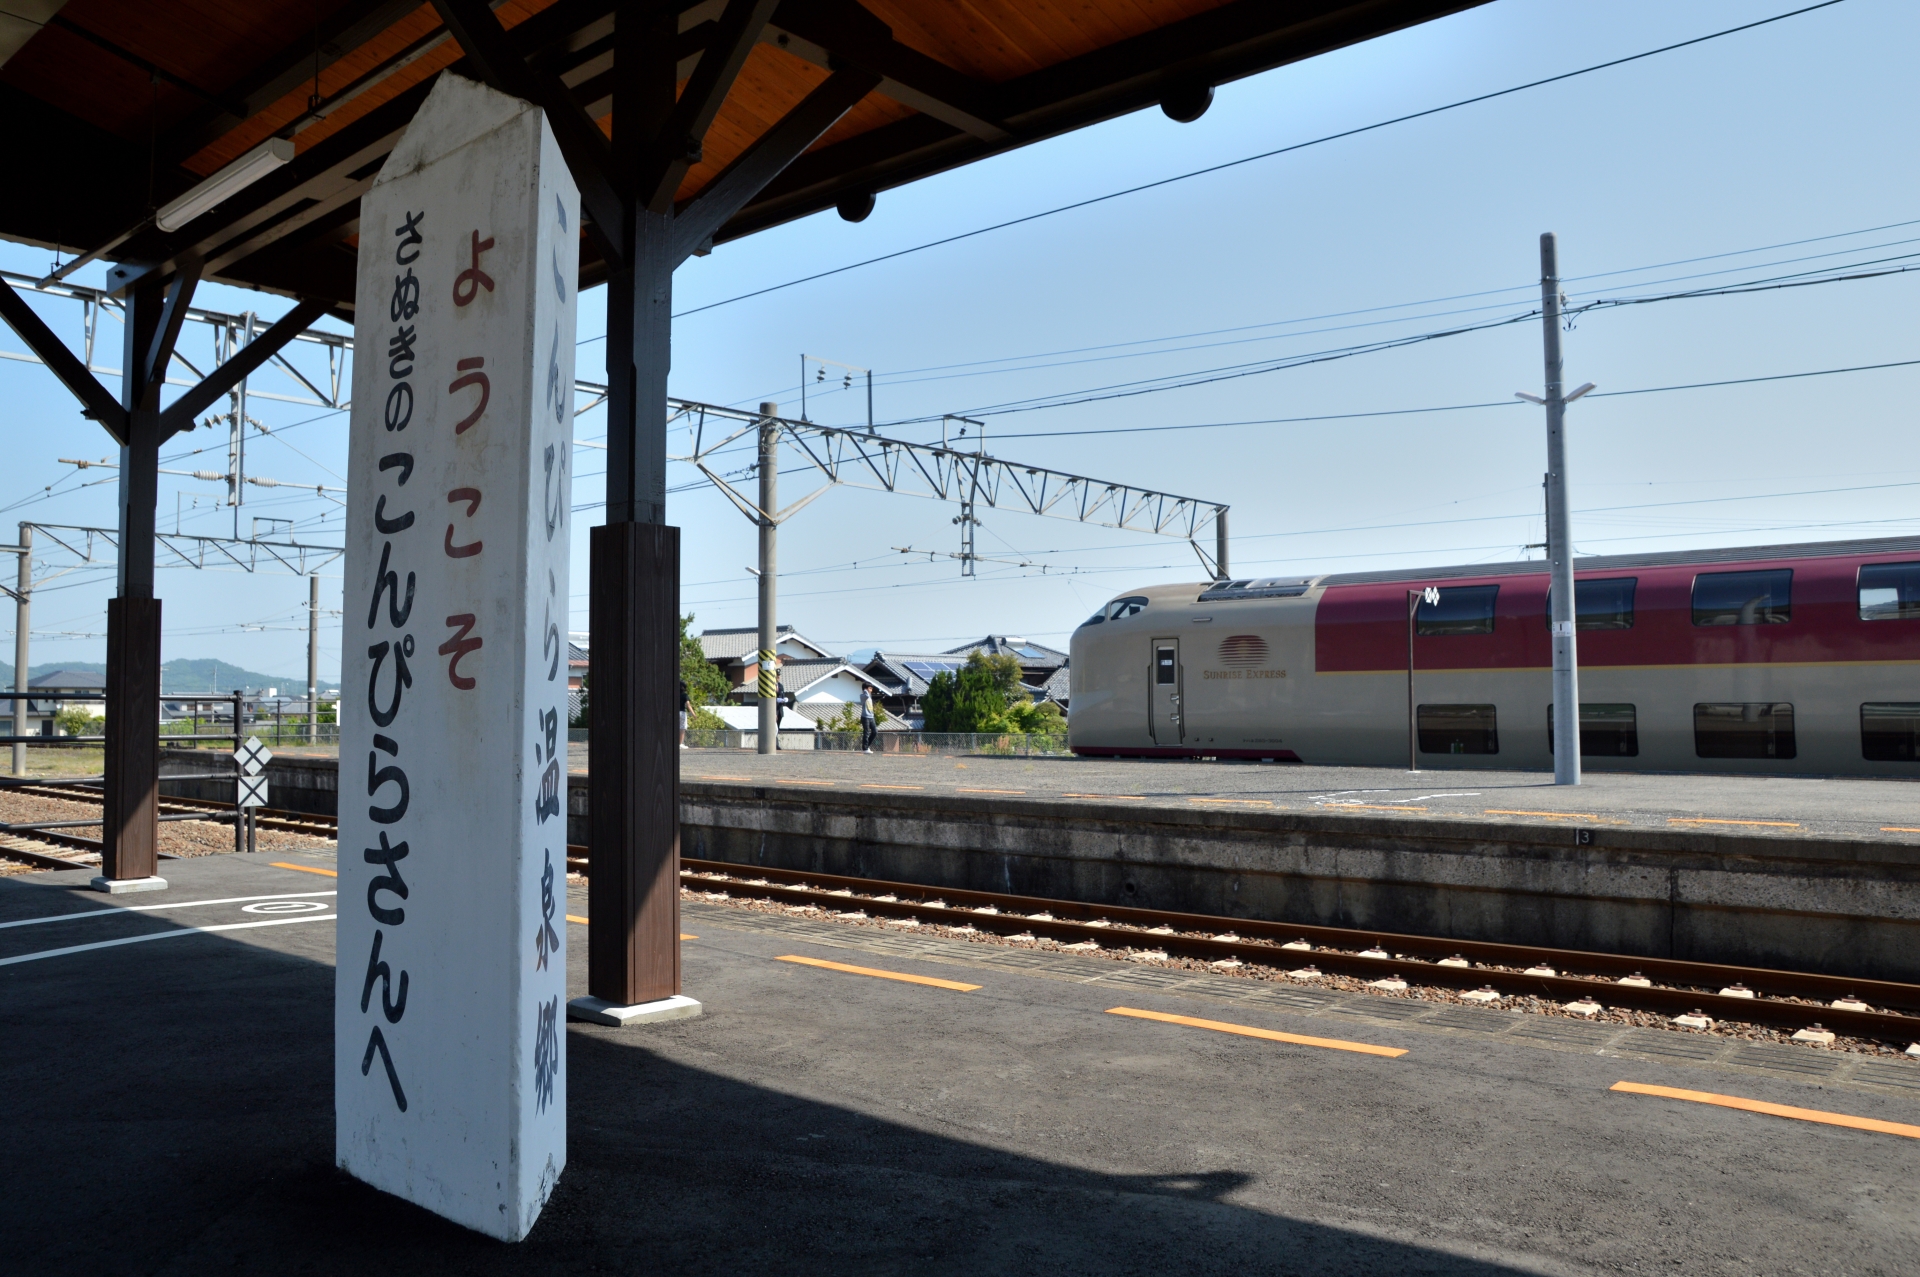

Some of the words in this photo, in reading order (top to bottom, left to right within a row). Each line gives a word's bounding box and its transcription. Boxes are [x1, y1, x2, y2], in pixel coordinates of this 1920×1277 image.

[360, 210, 424, 1113] さぬきのこんぴらさんへ
[438, 228, 495, 690] ようこそ
[534, 192, 567, 1116] こんぴら温泉郷
[1203, 670, 1243, 680] SUNRISE
[1246, 669, 1287, 679] EXPRESS
